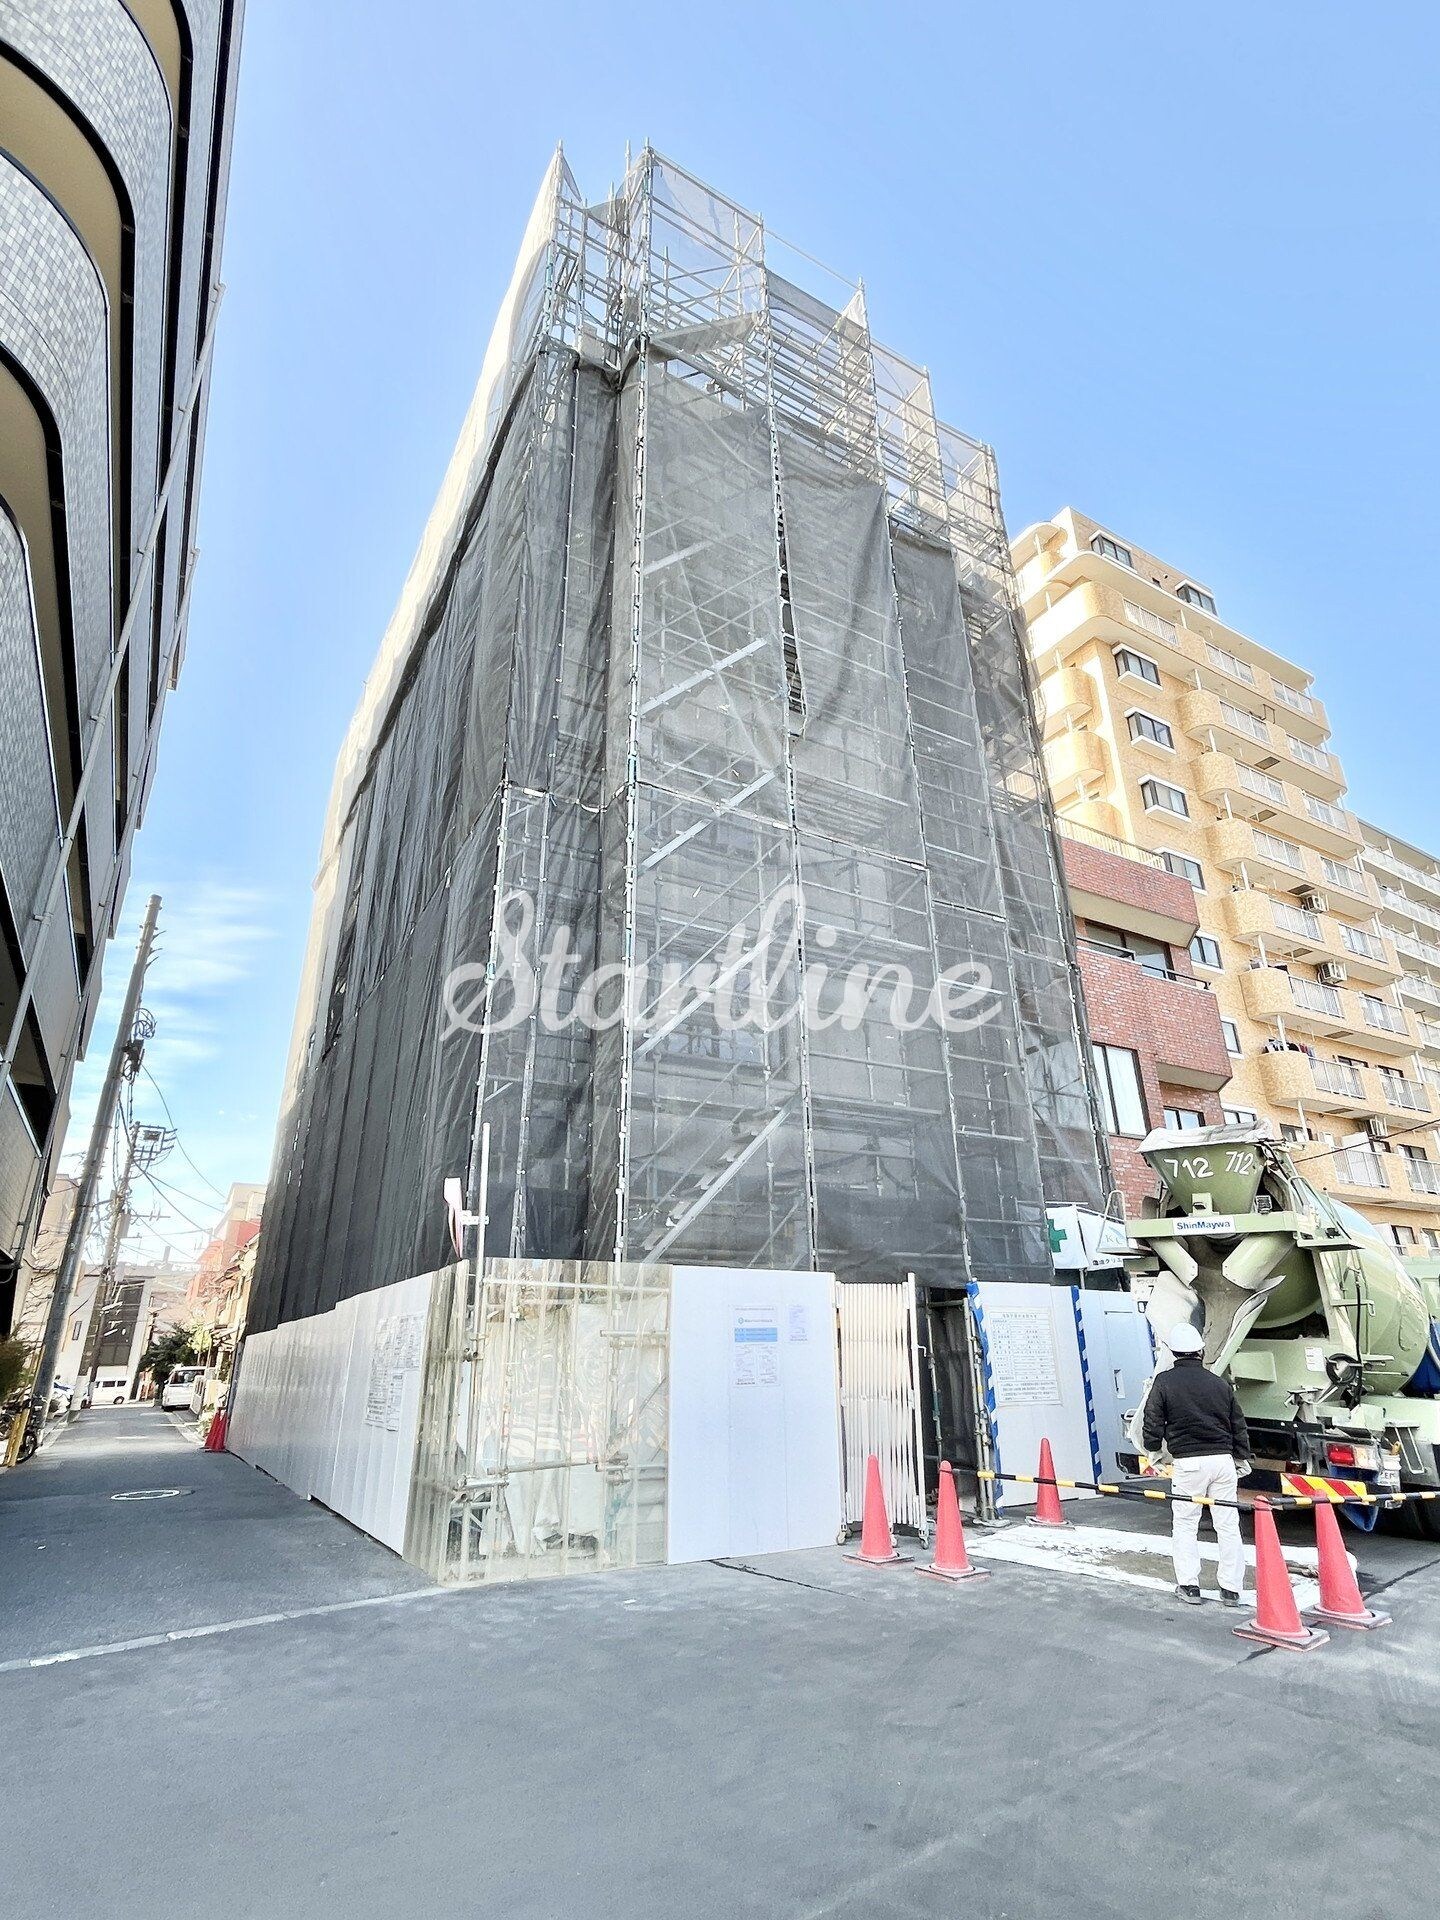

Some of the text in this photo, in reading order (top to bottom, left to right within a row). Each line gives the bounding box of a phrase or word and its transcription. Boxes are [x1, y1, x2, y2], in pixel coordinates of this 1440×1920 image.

[1163, 1151, 1254, 1179] 712 712
[1177, 1220, 1231, 1231] ShinMaywa
